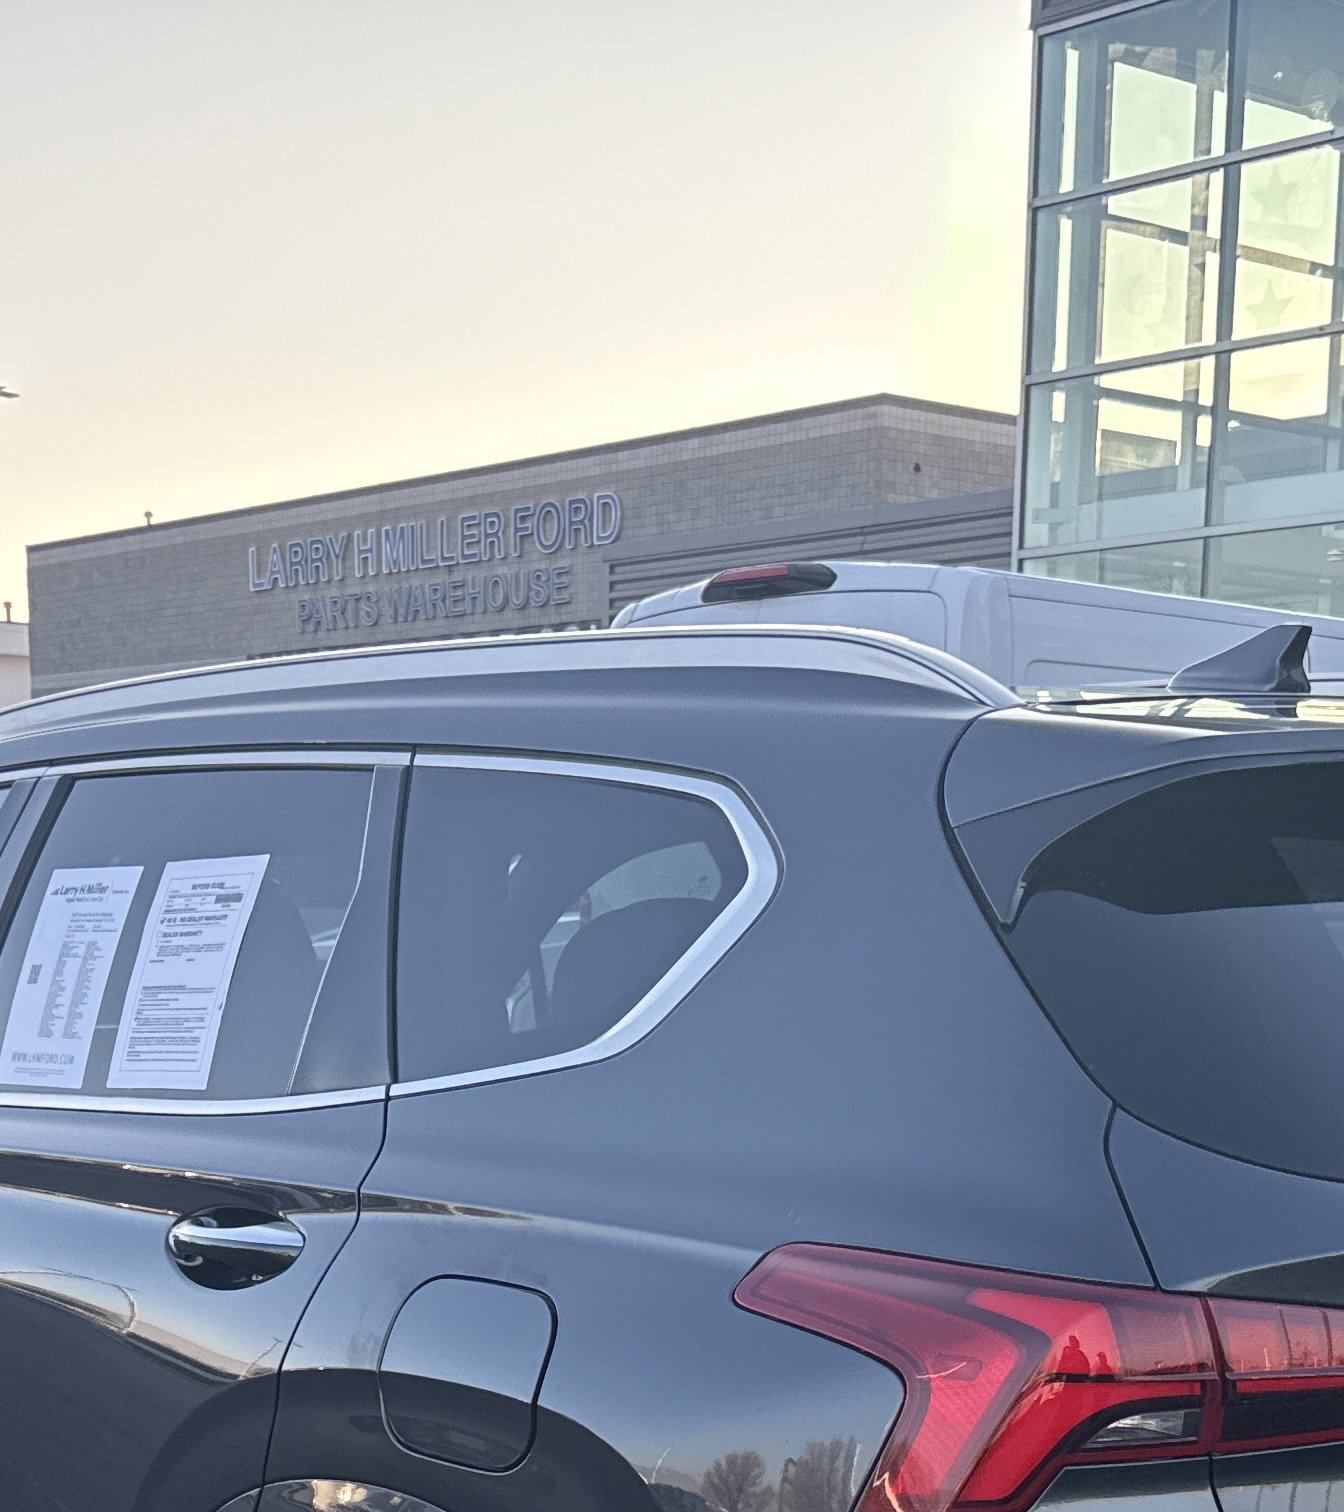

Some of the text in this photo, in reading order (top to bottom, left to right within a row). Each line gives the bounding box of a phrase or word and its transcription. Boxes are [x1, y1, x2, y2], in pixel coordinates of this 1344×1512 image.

[248, 491, 622, 592] LARRY H MILLER FORD
[296, 565, 572, 633] PARTS WAREHOUSE
